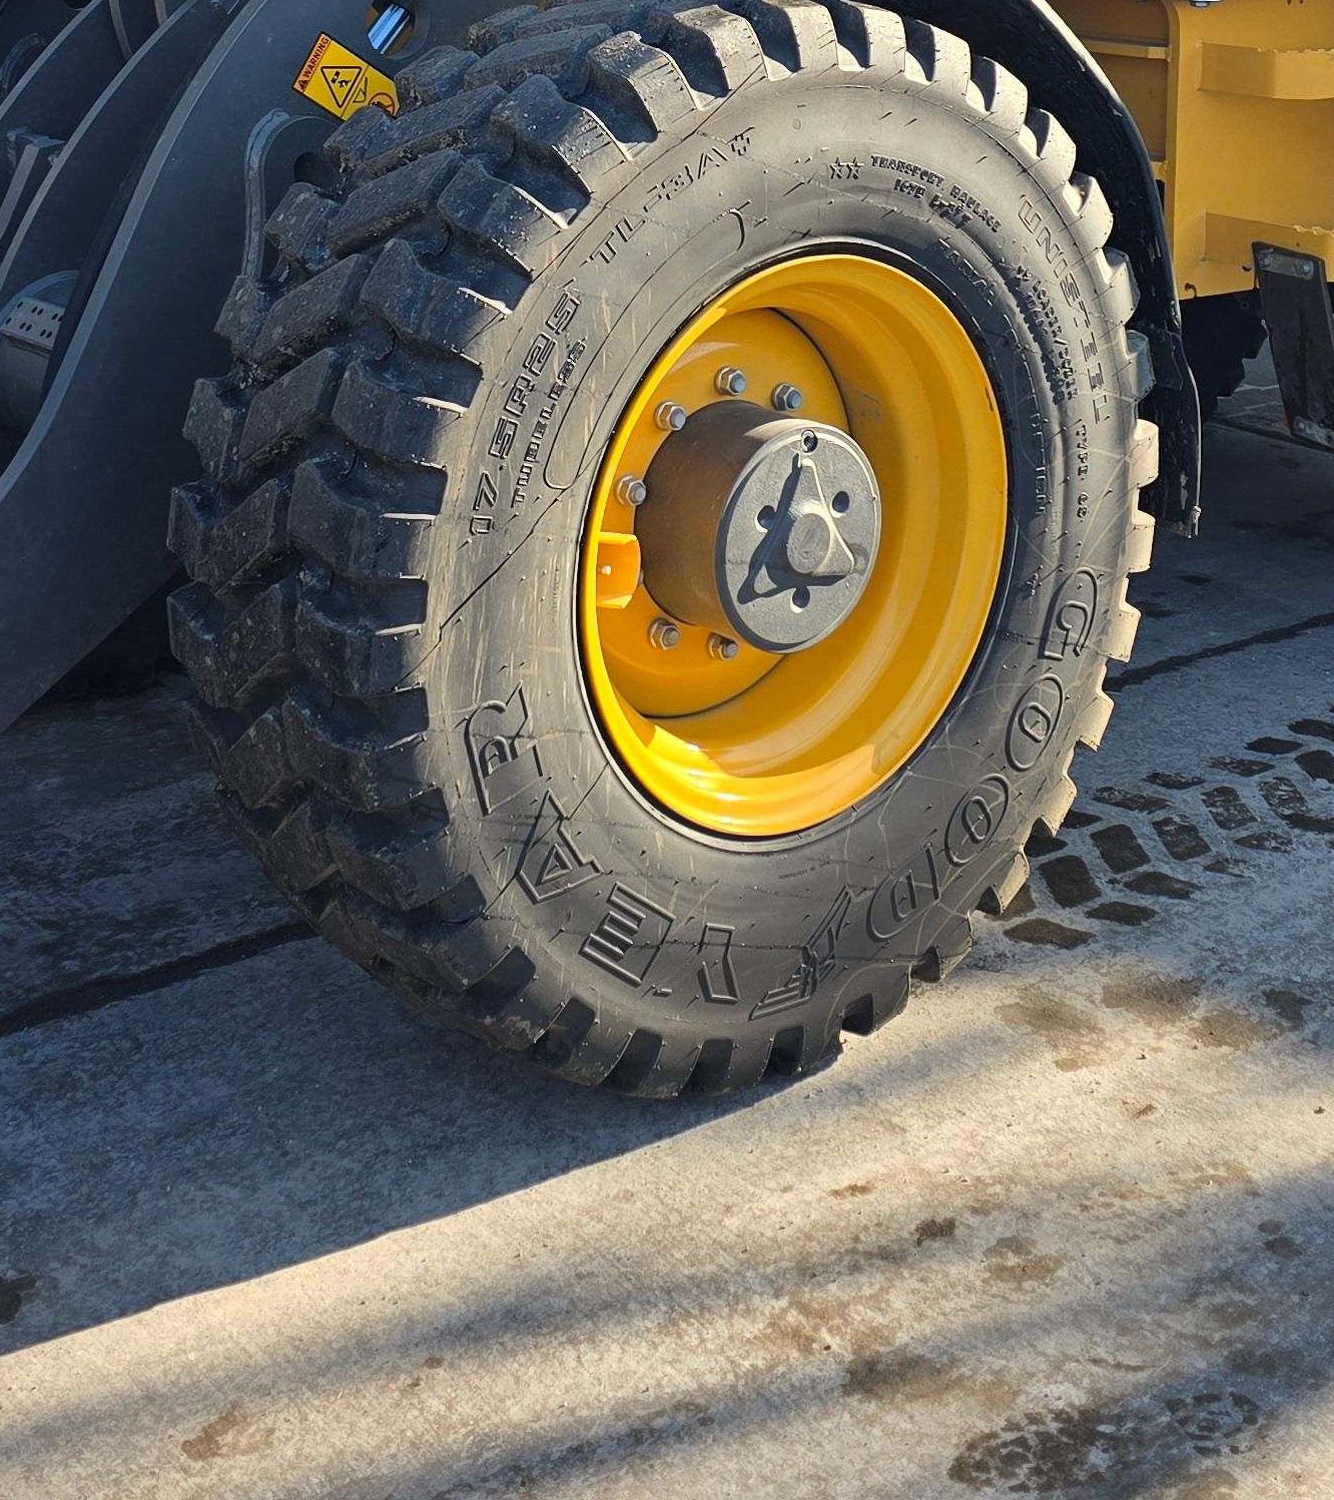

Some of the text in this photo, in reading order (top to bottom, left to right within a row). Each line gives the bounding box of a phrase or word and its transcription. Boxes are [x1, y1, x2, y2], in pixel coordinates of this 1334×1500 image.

[302, 37, 329, 78] WARNING
[468, 291, 582, 536] 17.5R25
[512, 339, 588, 509] TUBELESS
